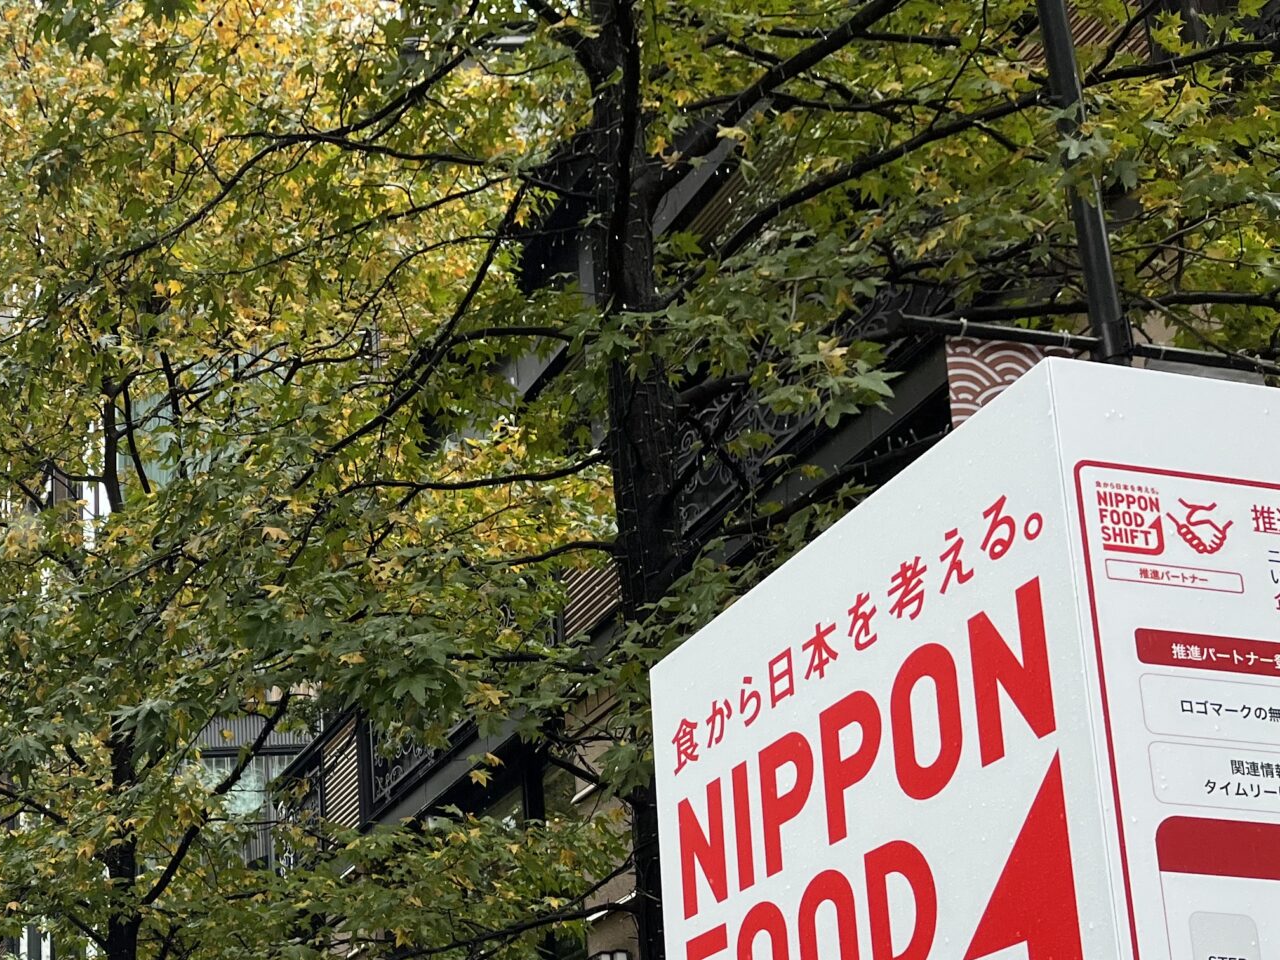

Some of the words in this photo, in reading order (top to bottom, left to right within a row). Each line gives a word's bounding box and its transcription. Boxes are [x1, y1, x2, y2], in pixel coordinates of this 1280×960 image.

[1097, 490, 1160, 512] NIPPON
[1099, 508, 1145, 527] FOOD
[1101, 525, 1151, 546] SHIFT
[1139, 567, 1208, 583] 推進パートナー
[671, 494, 1044, 776] 食から日本を考える。
[677, 576, 1057, 920] NIPPON
[1204, 779, 1280, 798] タイムリー
